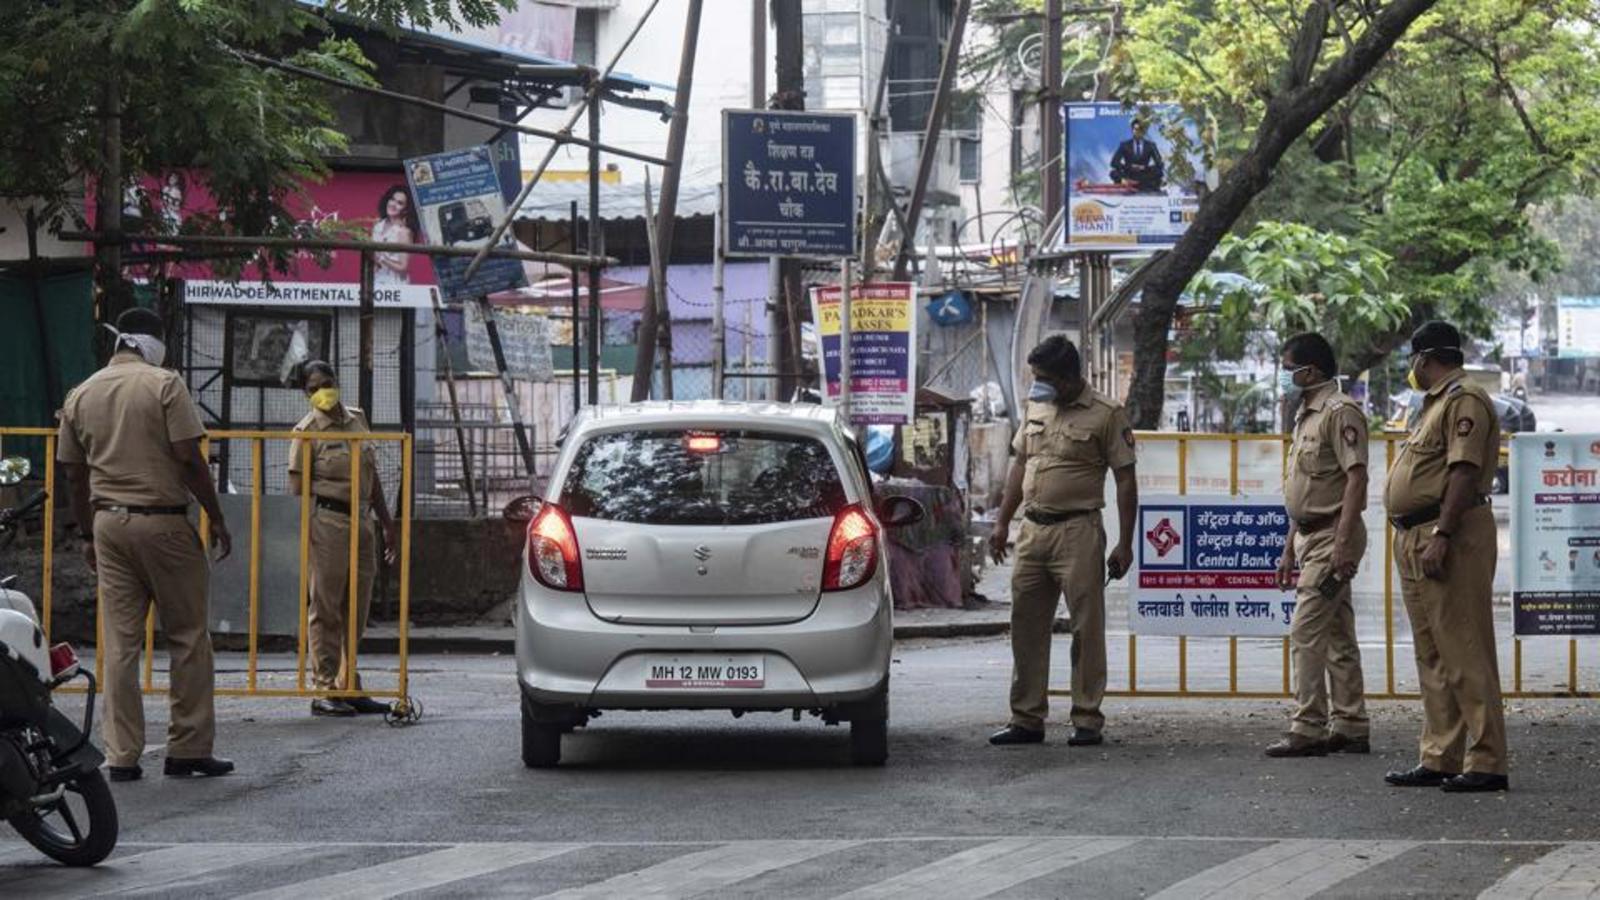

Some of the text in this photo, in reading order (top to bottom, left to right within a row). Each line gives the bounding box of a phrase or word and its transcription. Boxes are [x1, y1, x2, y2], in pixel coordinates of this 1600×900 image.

[779, 197, 804, 218] चौक
[1074, 223, 1114, 233] SHANTI
[187, 286, 242, 298] HIRWAD
[247, 287, 353, 301] DEPARTMENTAL
[824, 308, 906, 322] PAADKAR'S
[1542, 465, 1597, 487] करोना
[1197, 551, 1239, 567] Central
[1241, 551, 1271, 568] Bank
[1137, 594, 1185, 617] दत्तवाडी
[1190, 594, 1229, 618] पोलीस
[652, 666, 758, 679] MH 12 MW 0193
